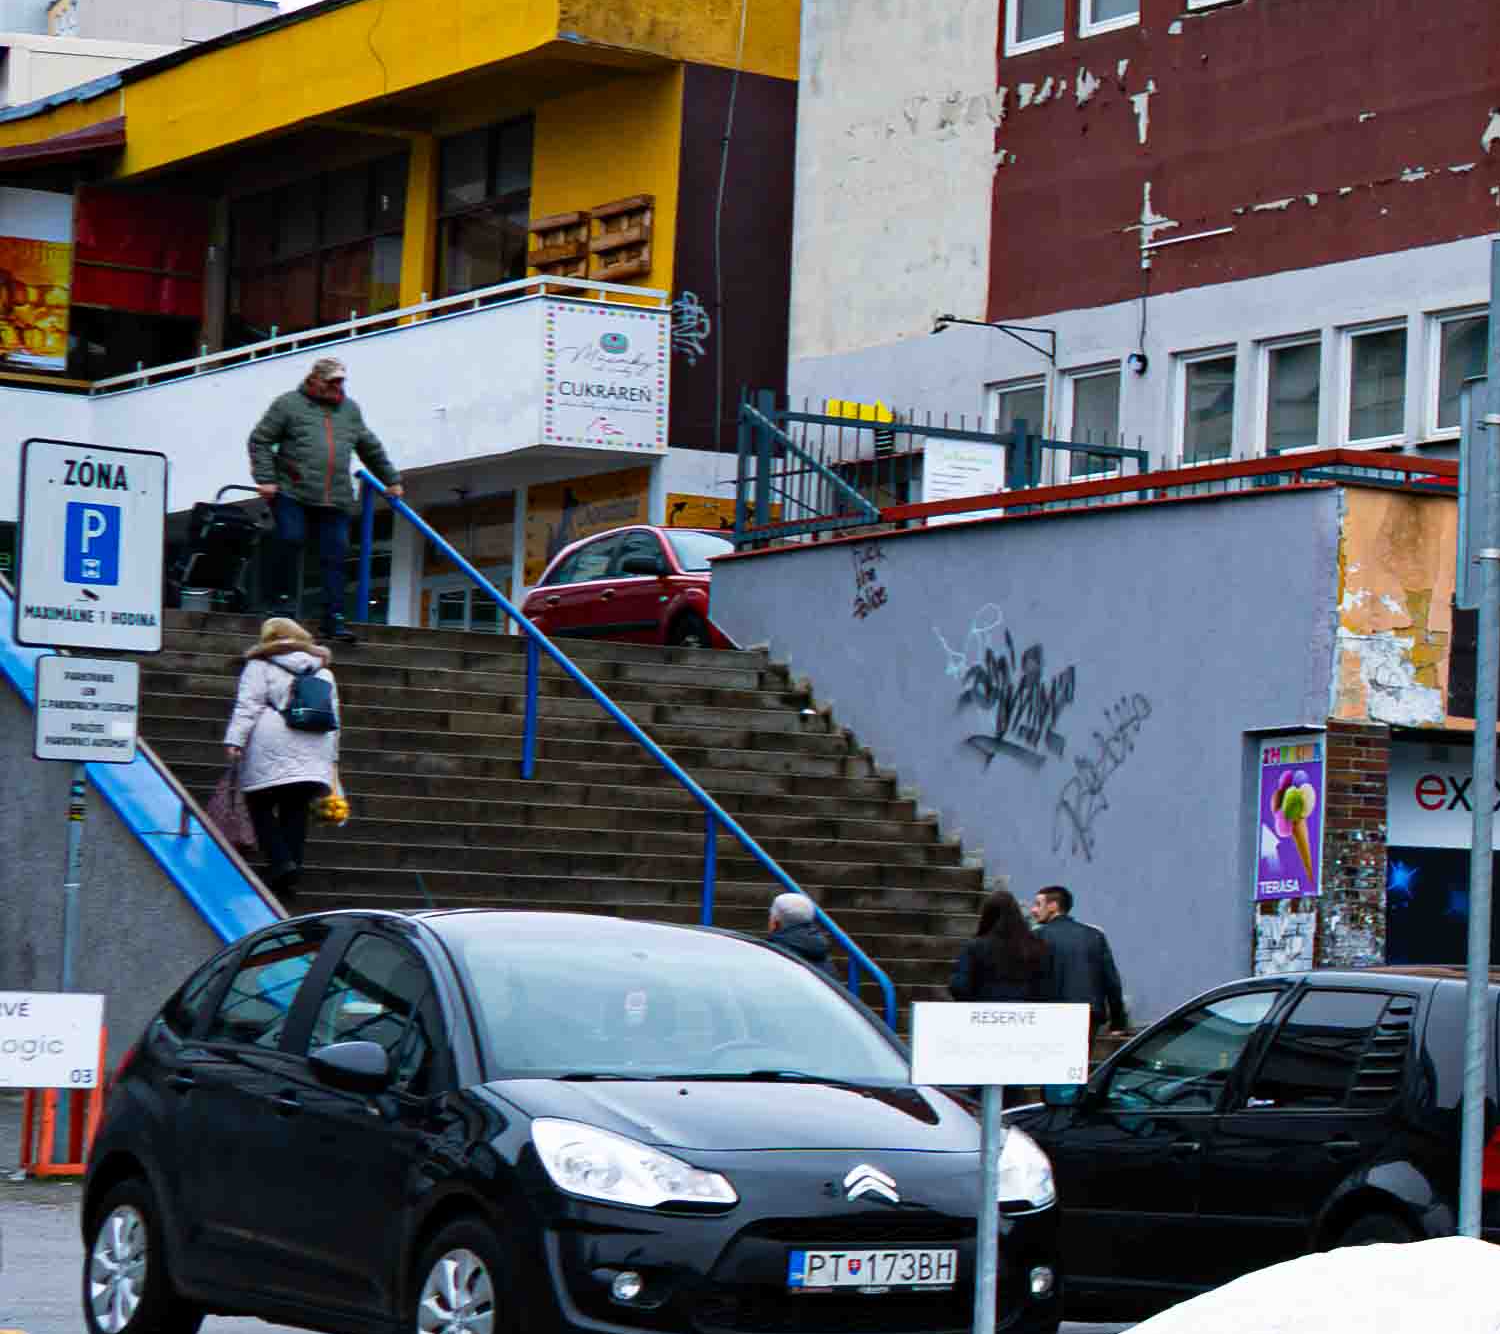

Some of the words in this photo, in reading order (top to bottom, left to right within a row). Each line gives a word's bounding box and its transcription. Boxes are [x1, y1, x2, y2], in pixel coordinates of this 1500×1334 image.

[560, 381, 653, 403] CUKRÁREŇ
[64, 455, 129, 491] ZÓNA
[80, 509, 107, 554] P
[111, 611, 157, 627] HODINA
[1259, 879, 1300, 894] TERASA
[71, 1069, 92, 1083] 03
